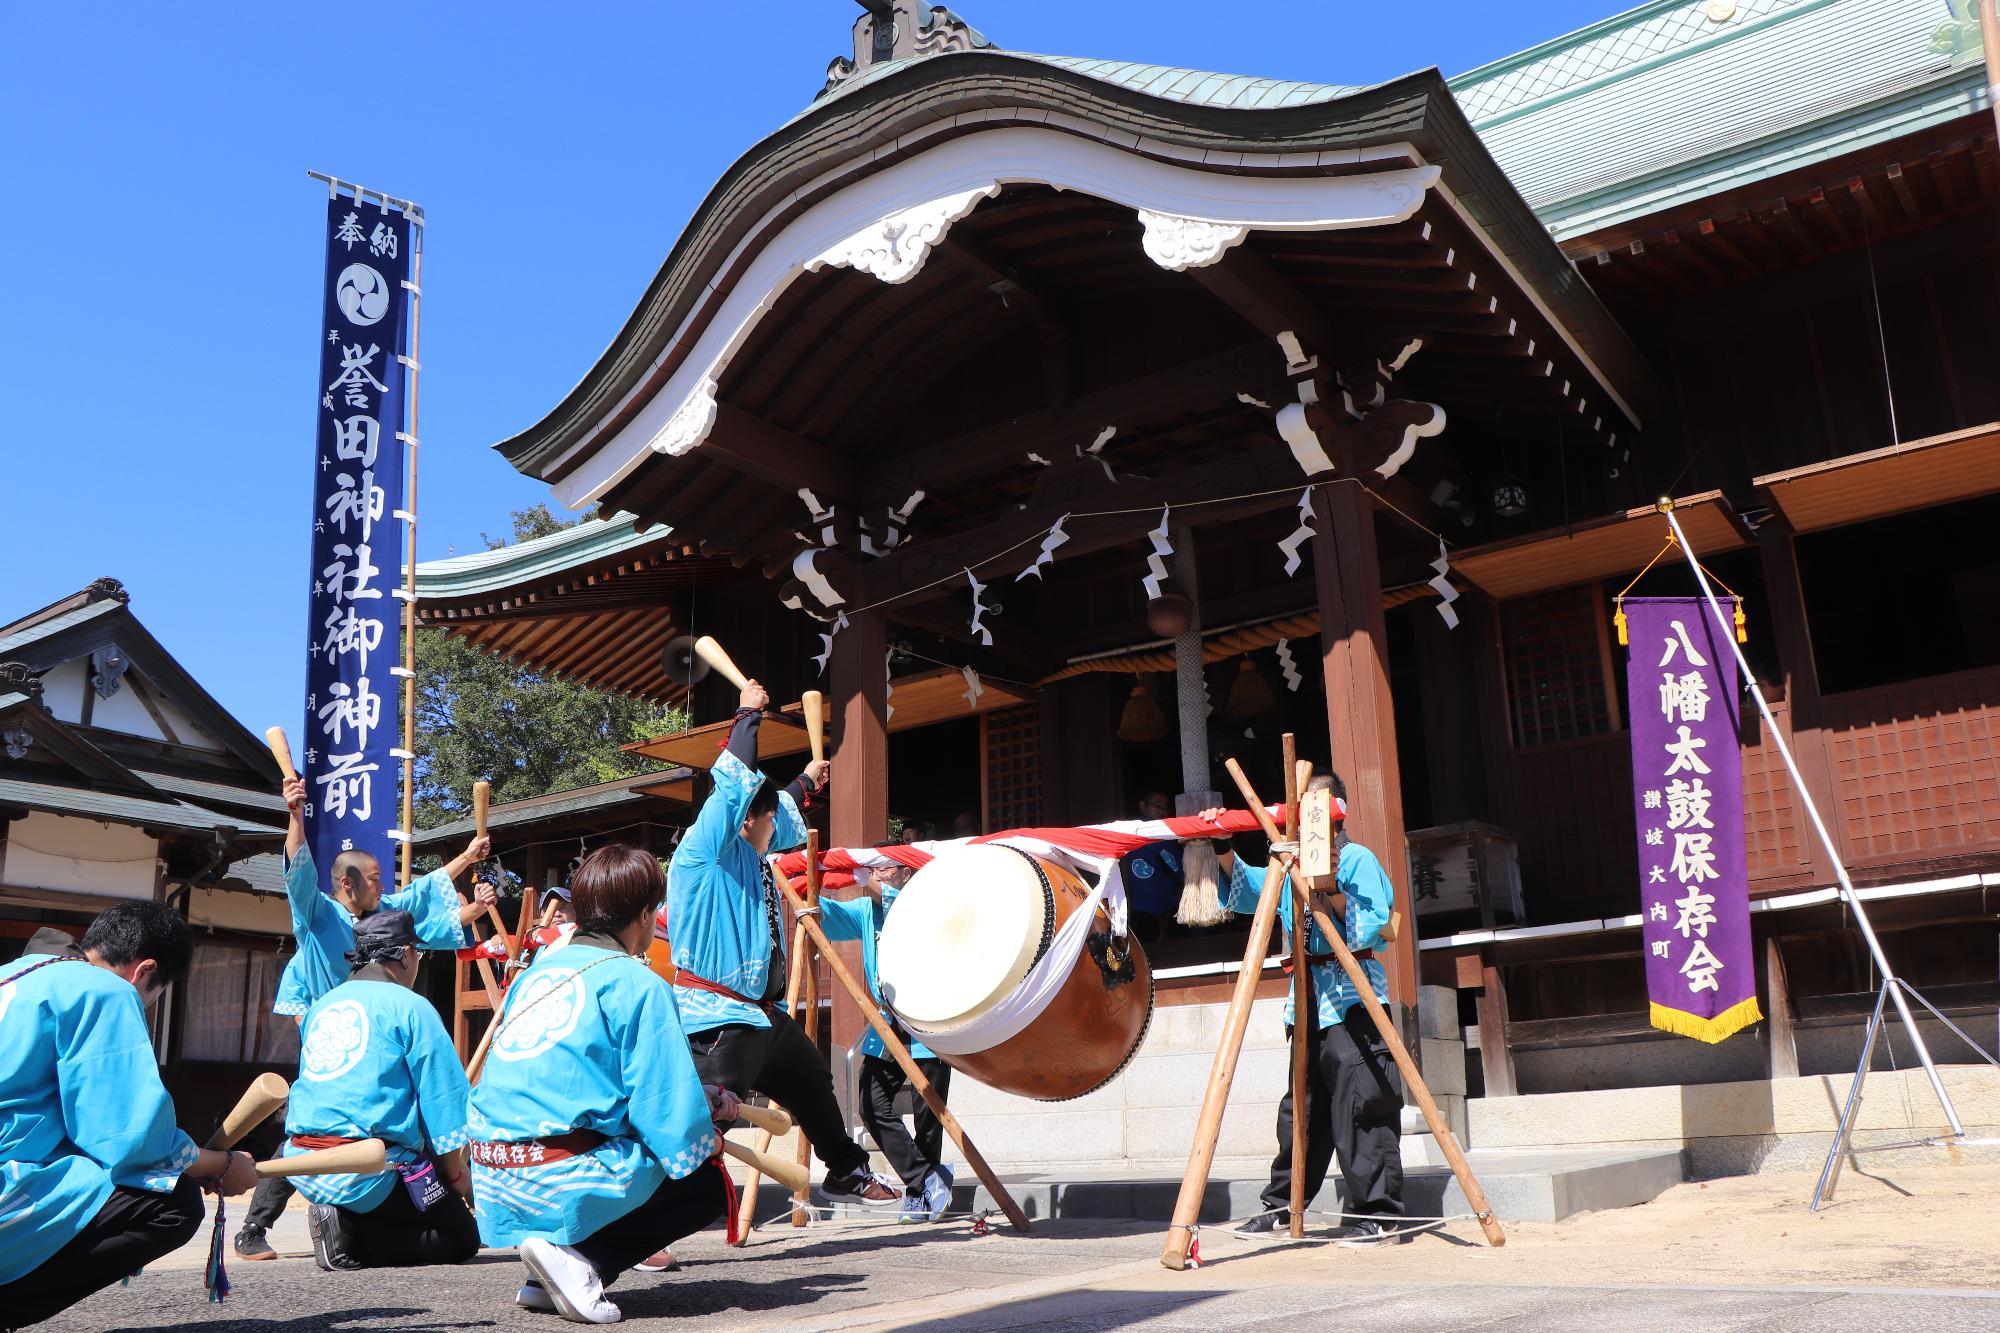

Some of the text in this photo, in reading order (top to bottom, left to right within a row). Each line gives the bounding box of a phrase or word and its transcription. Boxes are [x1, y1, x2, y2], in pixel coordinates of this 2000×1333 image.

[334, 211, 398, 260] 奉納
[316, 343, 389, 821] 誉田神社御神前
[1307, 806, 1326, 864] 宮入り
[1659, 620, 1724, 994] 八幡太鼓保存会
[1643, 790, 1671, 959] 讃岐大内町
[422, 1186, 445, 1204] BUNNY
[425, 1181, 440, 1195] JACK
